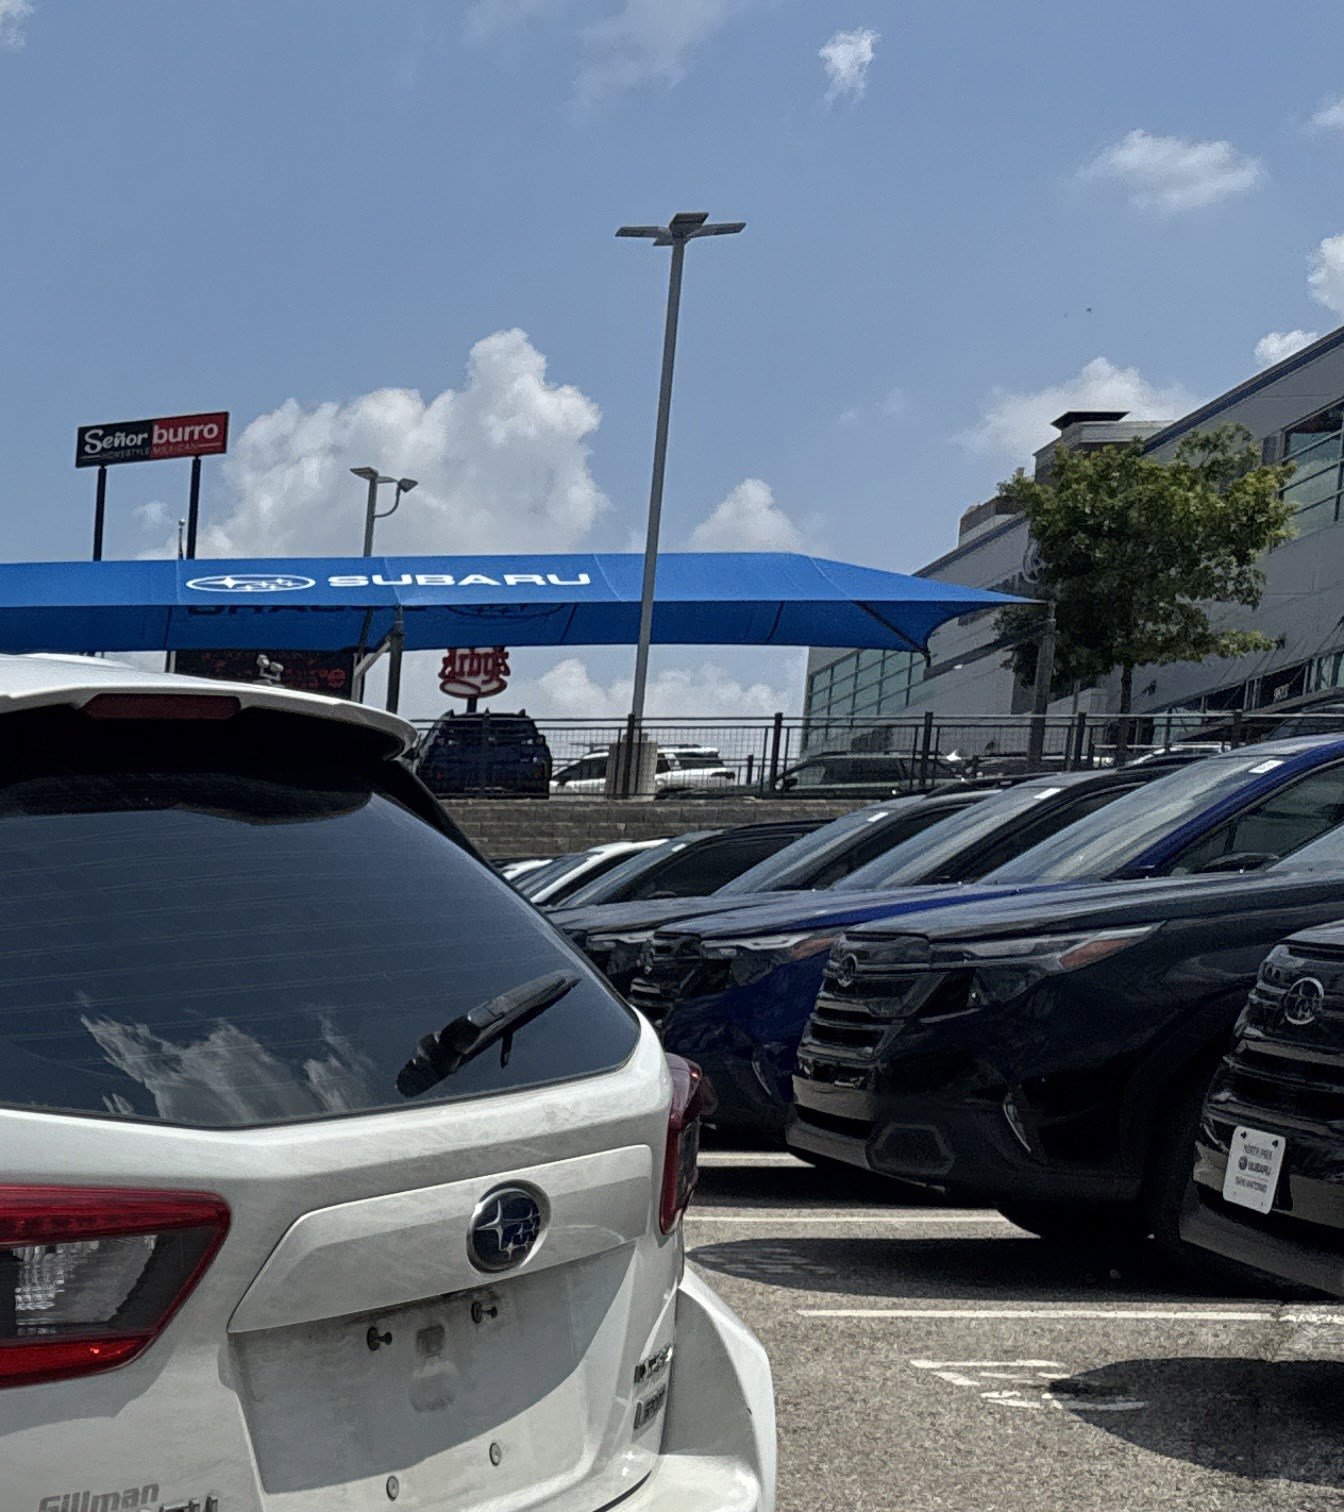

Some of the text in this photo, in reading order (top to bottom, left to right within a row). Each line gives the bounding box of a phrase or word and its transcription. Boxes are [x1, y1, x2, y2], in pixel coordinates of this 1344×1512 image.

[84, 423, 219, 453] Señor burro
[327, 573, 592, 587] SUBARU
